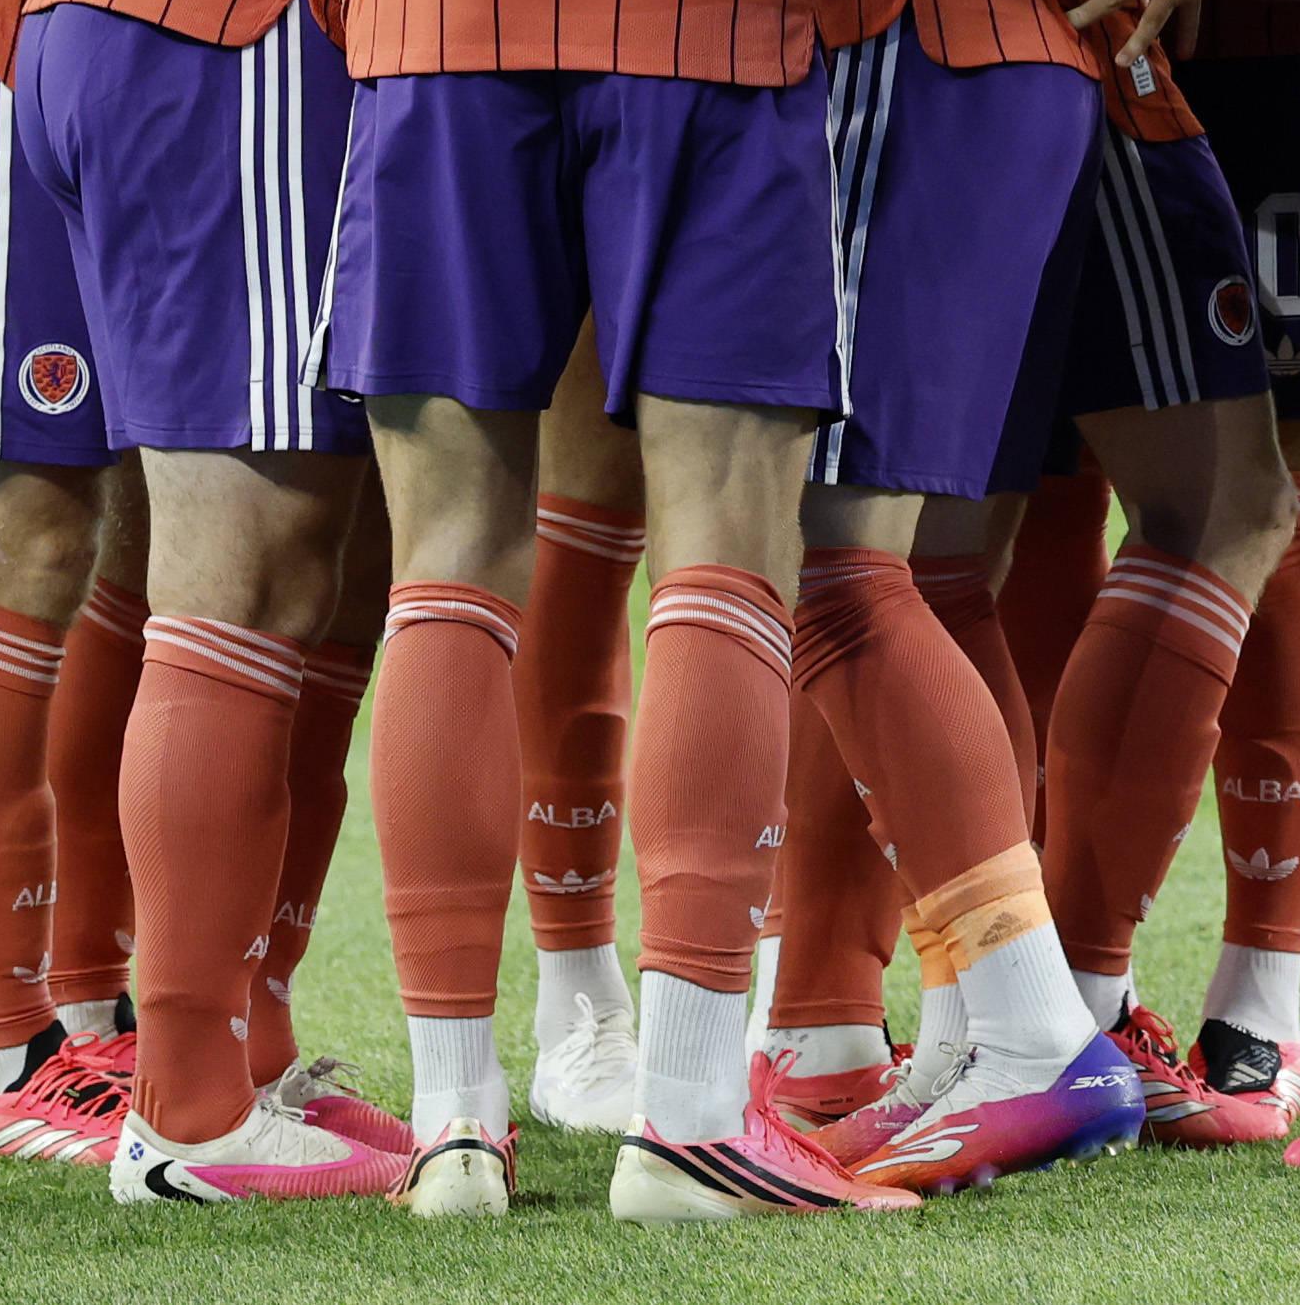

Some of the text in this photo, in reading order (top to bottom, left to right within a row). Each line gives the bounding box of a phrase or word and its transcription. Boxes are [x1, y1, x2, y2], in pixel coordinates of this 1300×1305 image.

[528, 800, 617, 828] ALBA
[755, 824, 787, 848] AL
[12, 879, 57, 912] AL
[274, 901, 317, 929] AL
[1068, 1074, 1130, 1090] SKX
